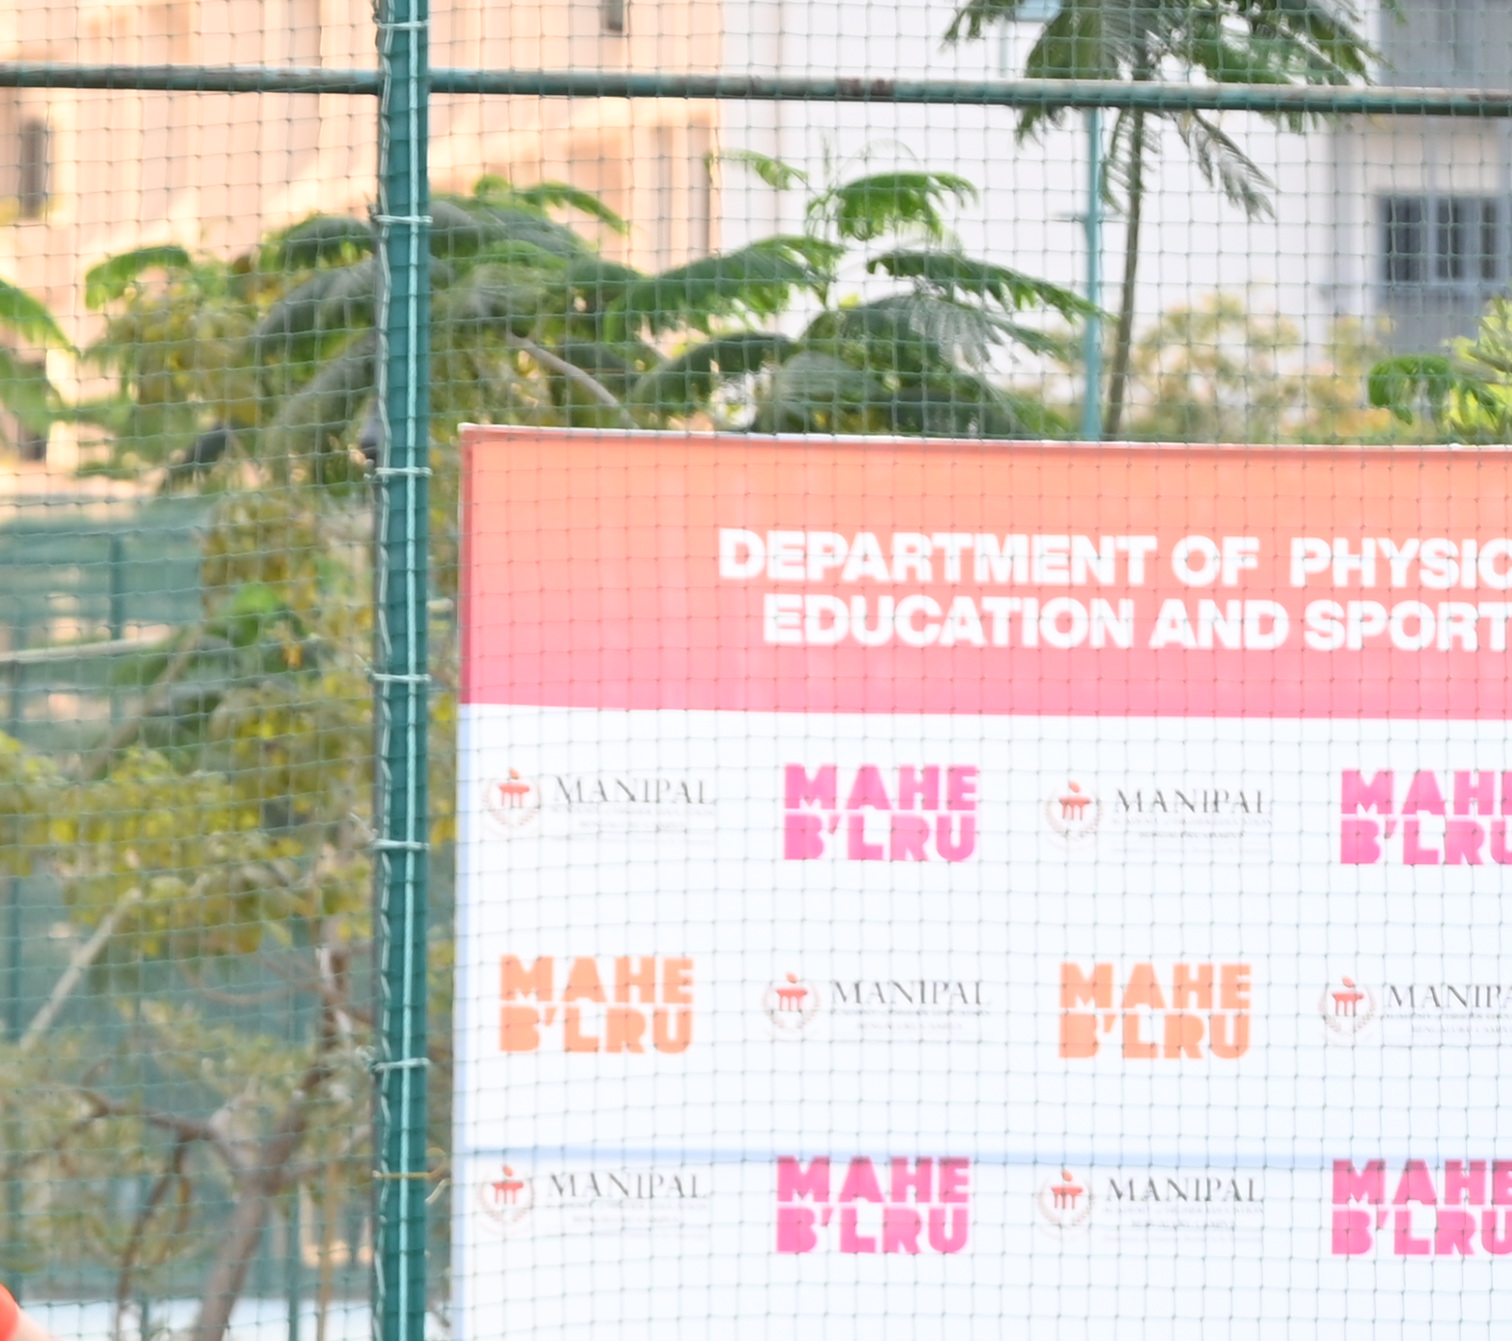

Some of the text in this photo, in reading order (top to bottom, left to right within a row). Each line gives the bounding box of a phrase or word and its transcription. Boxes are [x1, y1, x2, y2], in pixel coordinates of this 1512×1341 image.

[718, 527, 1158, 586] DEPARTMENT
[1170, 535, 1260, 588] OF
[763, 592, 1134, 649] EDUCATION
[1148, 598, 1290, 651] AND
[552, 776, 714, 804] MANIPAL
[786, 766, 978, 811] MAHE
[1114, 788, 1270, 813] MANIPAL
[786, 815, 976, 863] B'LRU
[502, 957, 693, 1005] MAHE
[830, 980, 989, 1006] MANIPAL
[1062, 965, 1251, 1010] MAHE
[502, 1007, 692, 1054] B'LRU
[1061, 1015, 1250, 1059] B'LRU
[547, 1172, 706, 1199] MANIPAL
[779, 1158, 970, 1204] MAHE
[1106, 1177, 1263, 1203] MANIPAL
[778, 1208, 968, 1255] B'LRU
